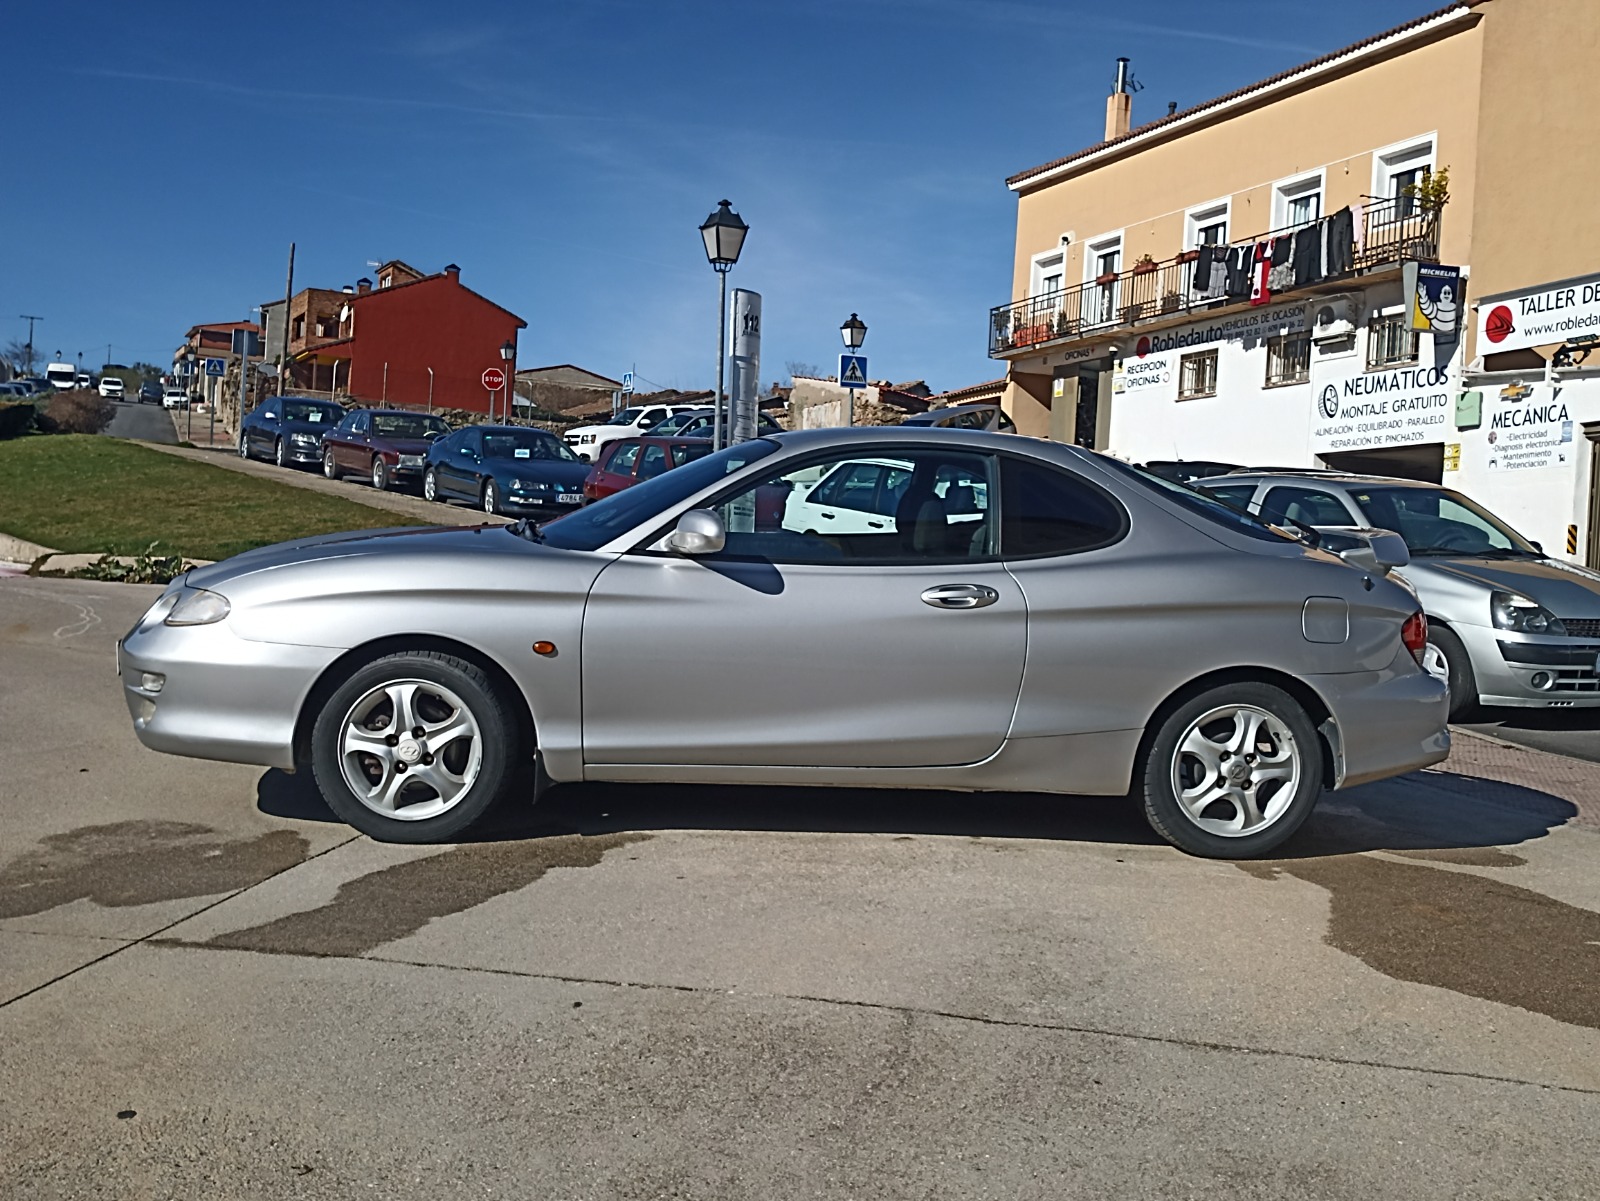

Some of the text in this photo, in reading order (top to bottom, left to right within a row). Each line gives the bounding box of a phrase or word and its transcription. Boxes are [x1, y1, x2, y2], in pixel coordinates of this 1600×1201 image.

[1420, 268, 1457, 278] MICHELIN
[1518, 289, 1575, 315] TALLER
[743, 313, 759, 333] 112
[1261, 313, 1270, 323] DE
[1524, 313, 1600, 337] www.robleda
[1151, 327, 1222, 353] Robledauto
[1064, 348, 1090, 361] OFICINAS
[1127, 374, 1160, 388] OFICINAS
[1340, 393, 1448, 419] MONTAJE GRATUITO
[1491, 403, 1569, 429] MECÁNICA
[1374, 436, 1383, 445] DE
[1386, 431, 1425, 443] PINCHAZOS
